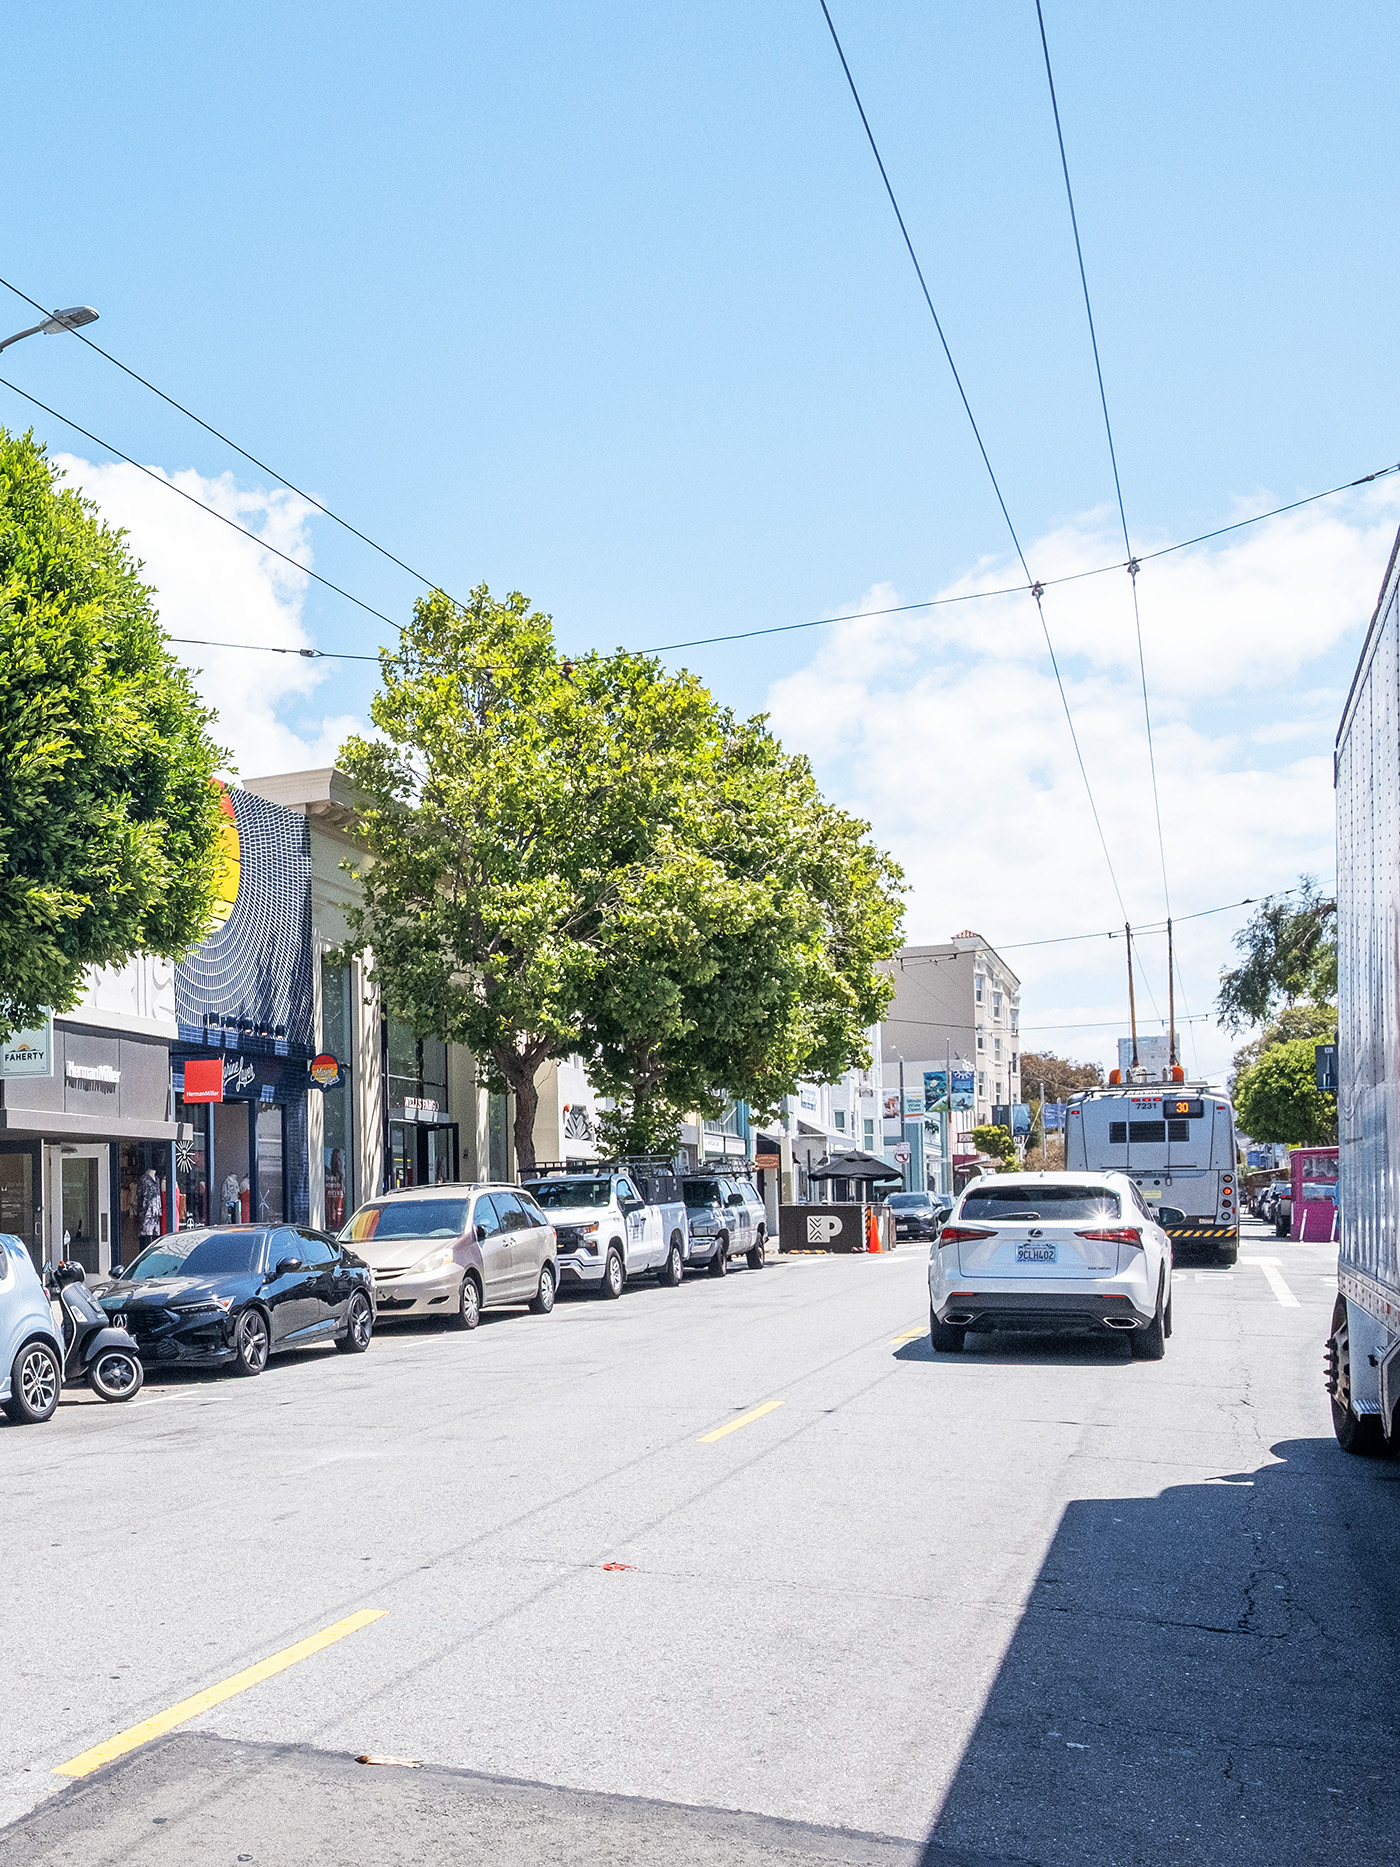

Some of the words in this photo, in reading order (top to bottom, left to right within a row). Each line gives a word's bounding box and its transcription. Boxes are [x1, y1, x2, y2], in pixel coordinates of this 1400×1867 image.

[4, 1052, 45, 1061] FAHERTY
[404, 1096, 422, 1109] WELLS
[1176, 1102, 1189, 1113] 30
[1018, 1249, 1054, 1260] 9CLH402
